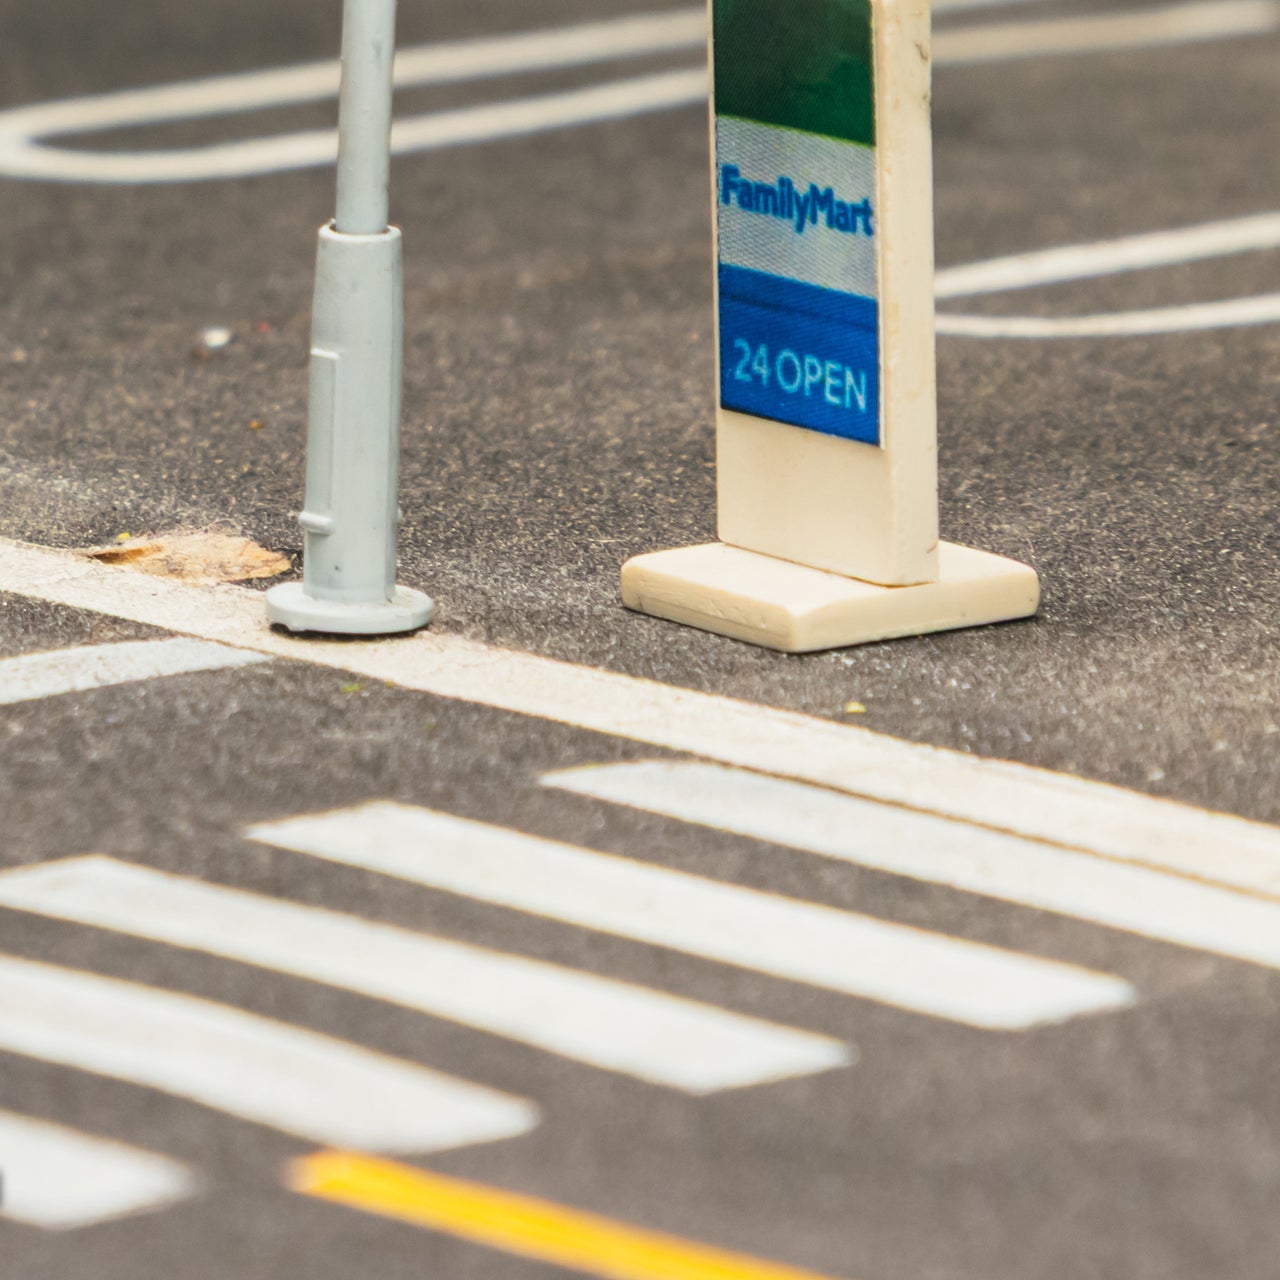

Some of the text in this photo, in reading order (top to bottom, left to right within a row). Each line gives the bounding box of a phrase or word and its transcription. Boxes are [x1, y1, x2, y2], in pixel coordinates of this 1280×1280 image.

[721, 163, 874, 237] FamilyMart
[733, 337, 867, 413] 24 OPEN
